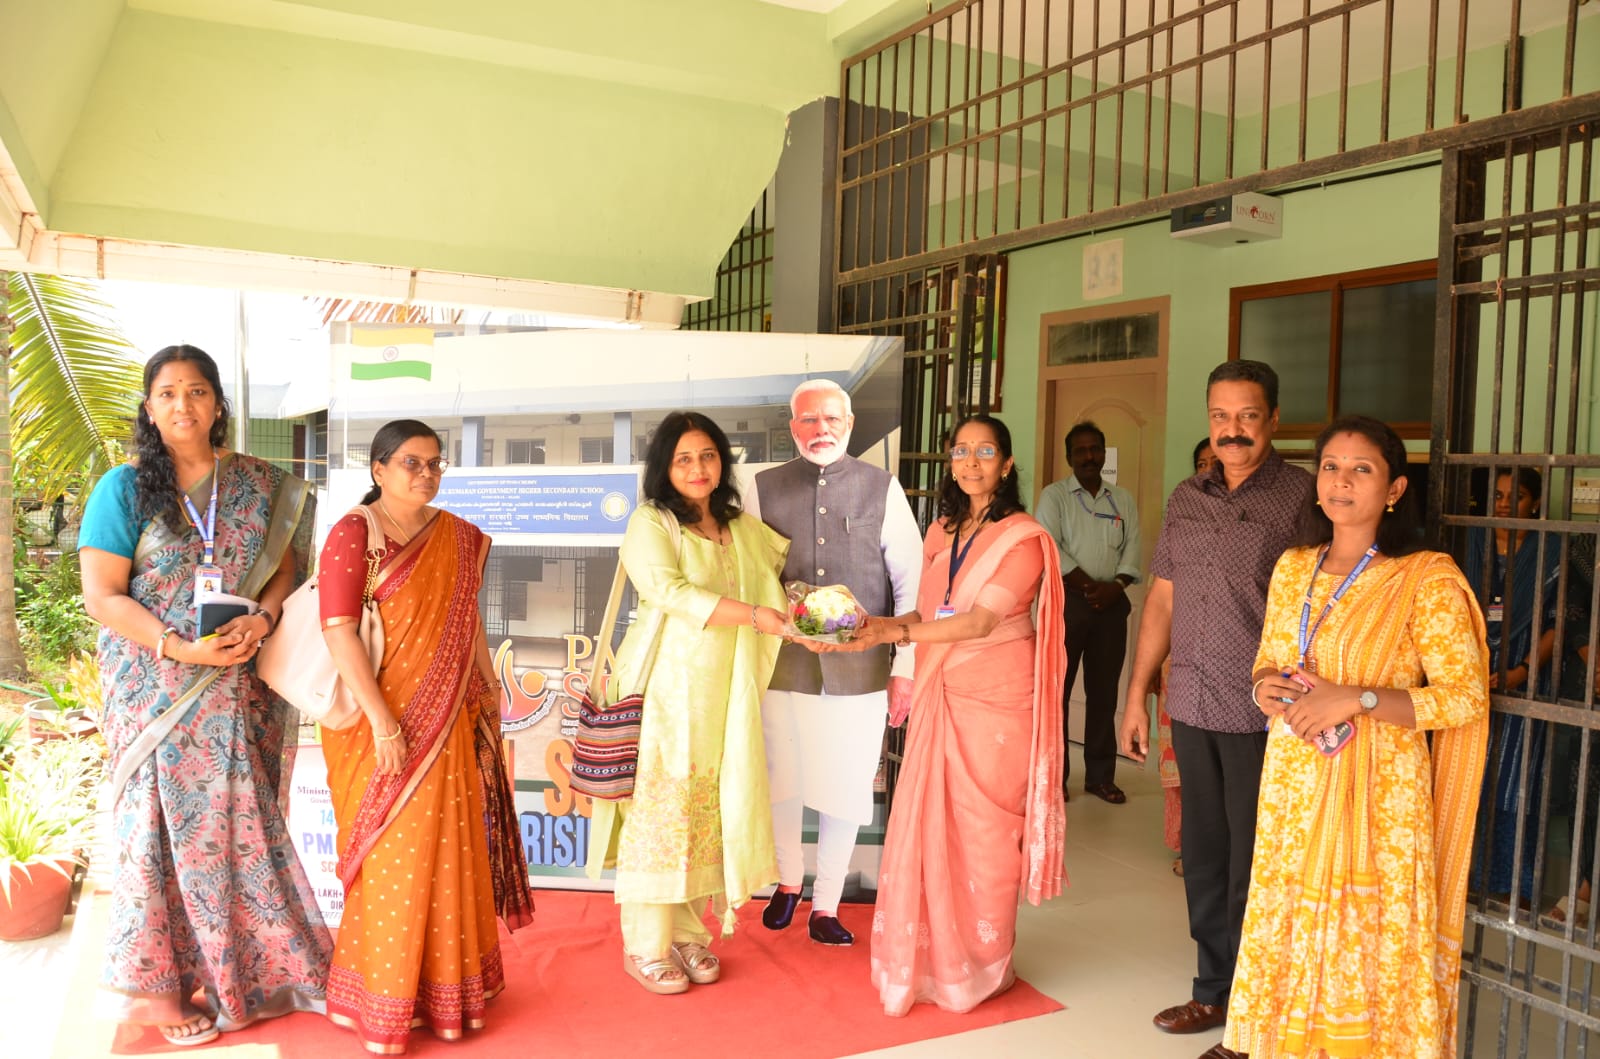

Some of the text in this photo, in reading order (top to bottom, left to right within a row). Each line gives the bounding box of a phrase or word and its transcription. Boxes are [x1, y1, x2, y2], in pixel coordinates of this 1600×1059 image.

[302, 832, 334, 855] PM
[520, 813, 592, 867] RISI
[330, 900, 344, 911] DIR
